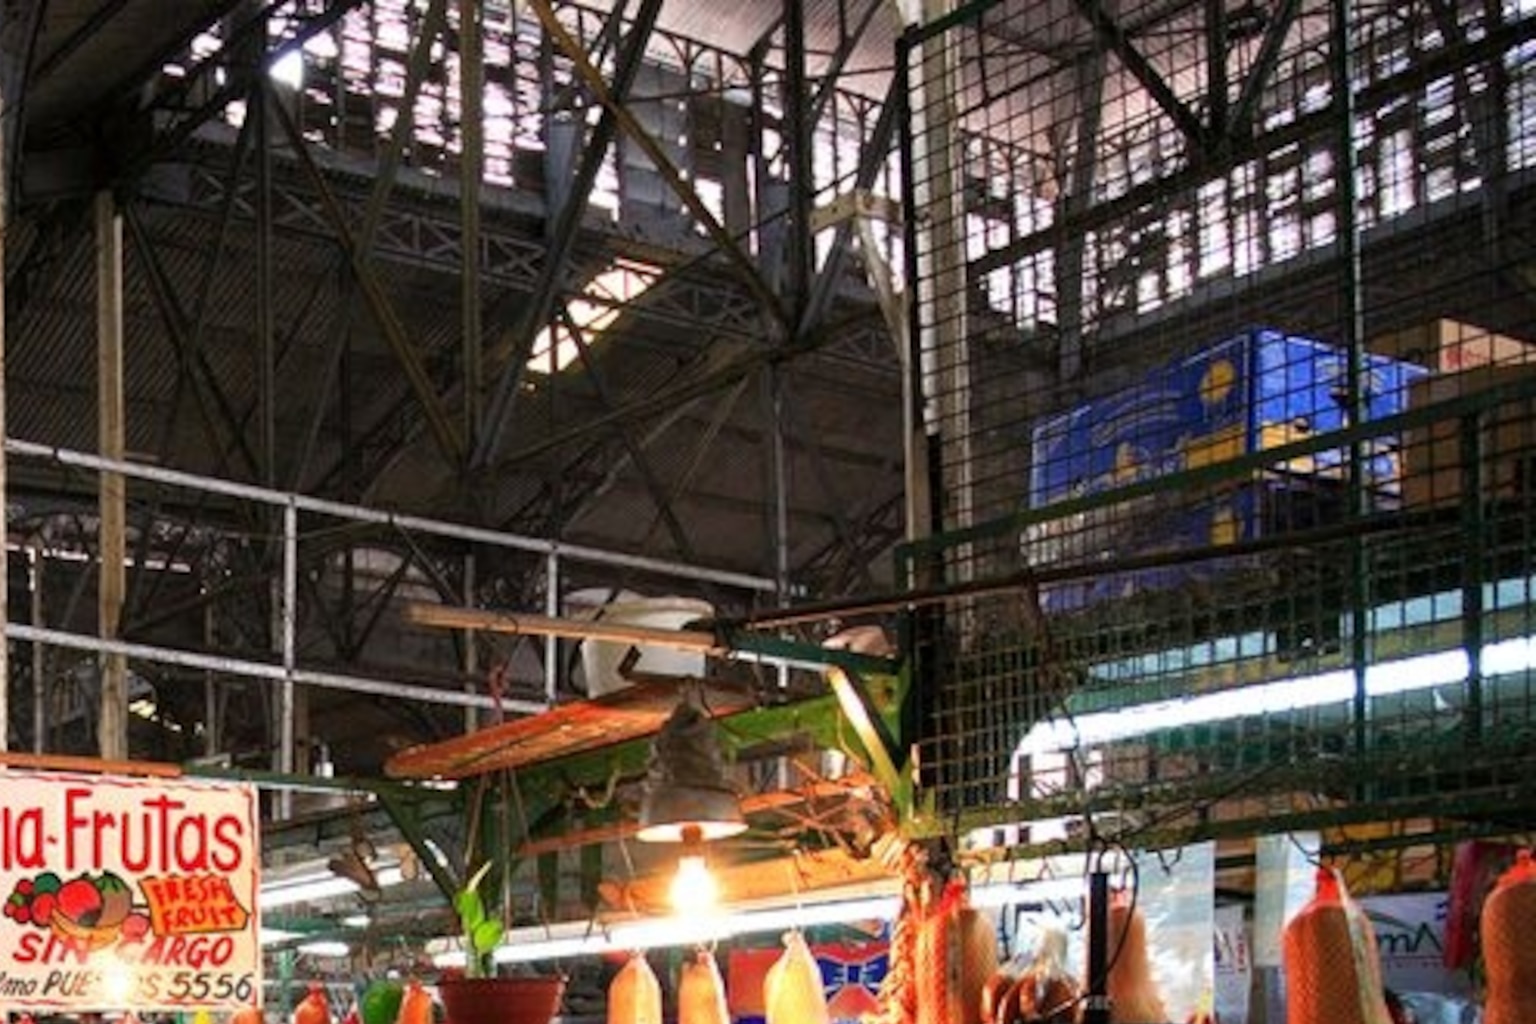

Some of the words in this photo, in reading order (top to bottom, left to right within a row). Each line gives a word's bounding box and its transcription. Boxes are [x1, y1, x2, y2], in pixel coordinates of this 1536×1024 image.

[152, 877, 233, 906] FRESH
[161, 905, 237, 935] FRUIT
[12, 933, 89, 965] SIN
[167, 972, 255, 1001] 5556
